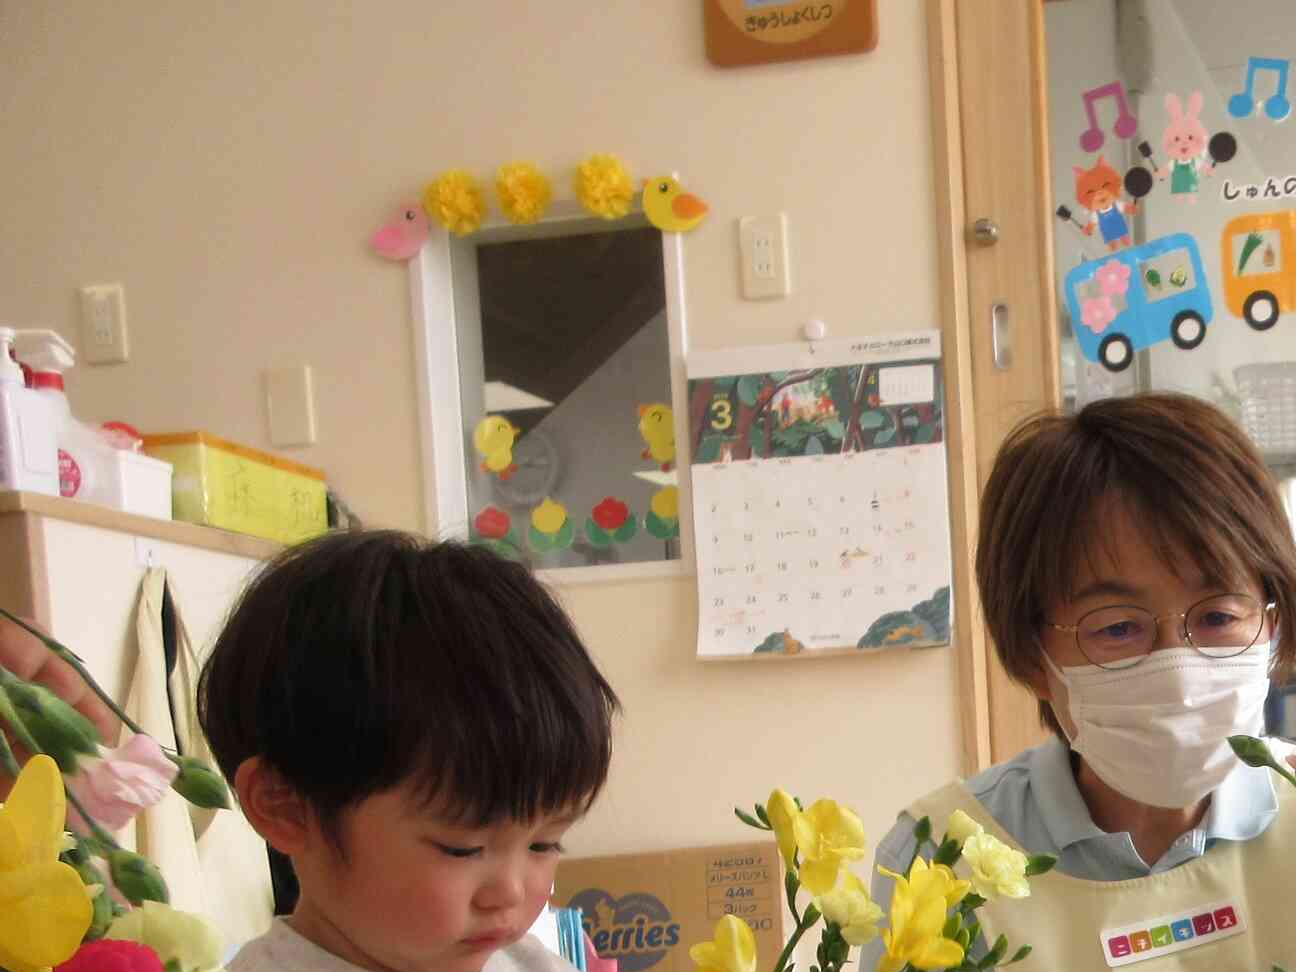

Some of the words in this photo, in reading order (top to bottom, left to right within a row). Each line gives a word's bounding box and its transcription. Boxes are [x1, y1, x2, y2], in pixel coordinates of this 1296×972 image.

[744, 4, 833, 32] きゅうしょくしつ
[710, 400, 733, 430] 3
[583, 914, 681, 951] erries
